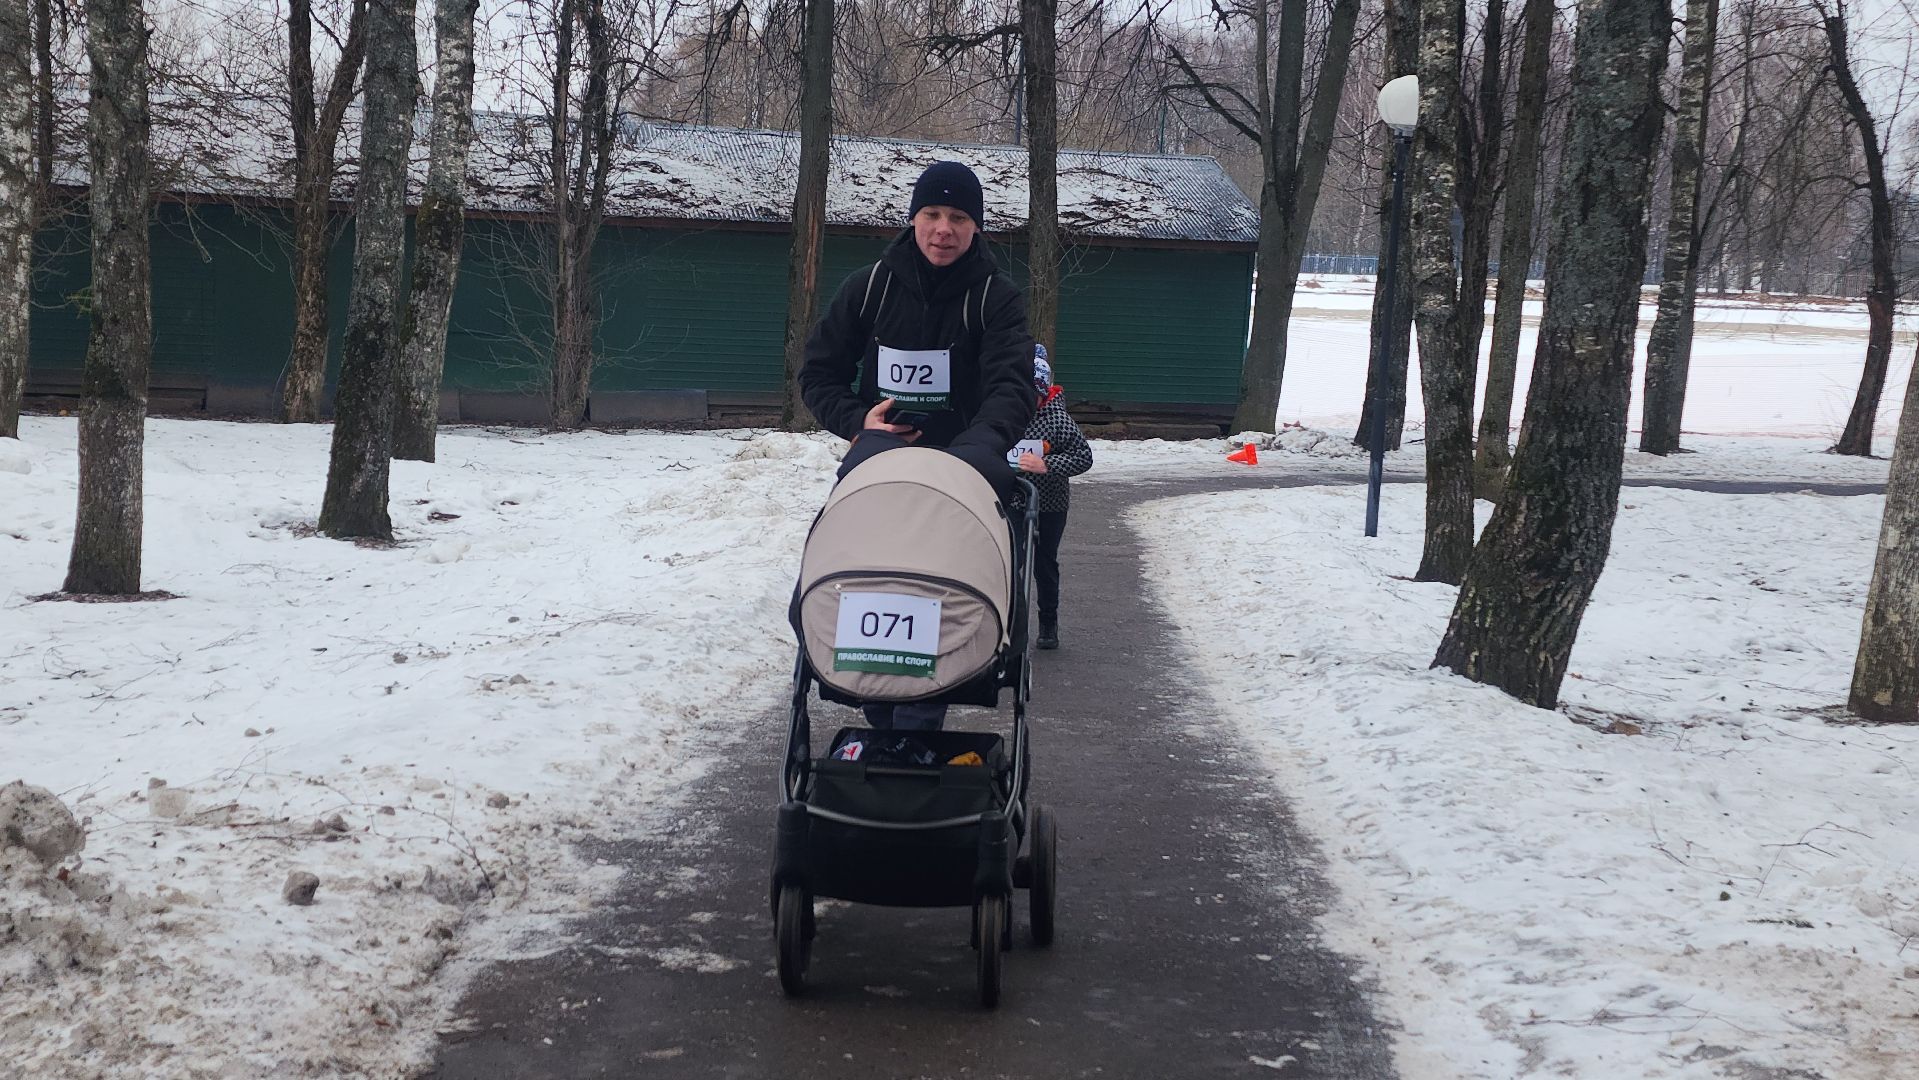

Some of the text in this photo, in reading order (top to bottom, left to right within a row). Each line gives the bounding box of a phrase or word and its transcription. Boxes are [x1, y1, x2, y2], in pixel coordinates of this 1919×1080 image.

[890, 364, 932, 384] 072
[860, 612, 914, 640] 071
[838, 652, 932, 666] ПРАВОСЛАВИЕ И СПОРТ
